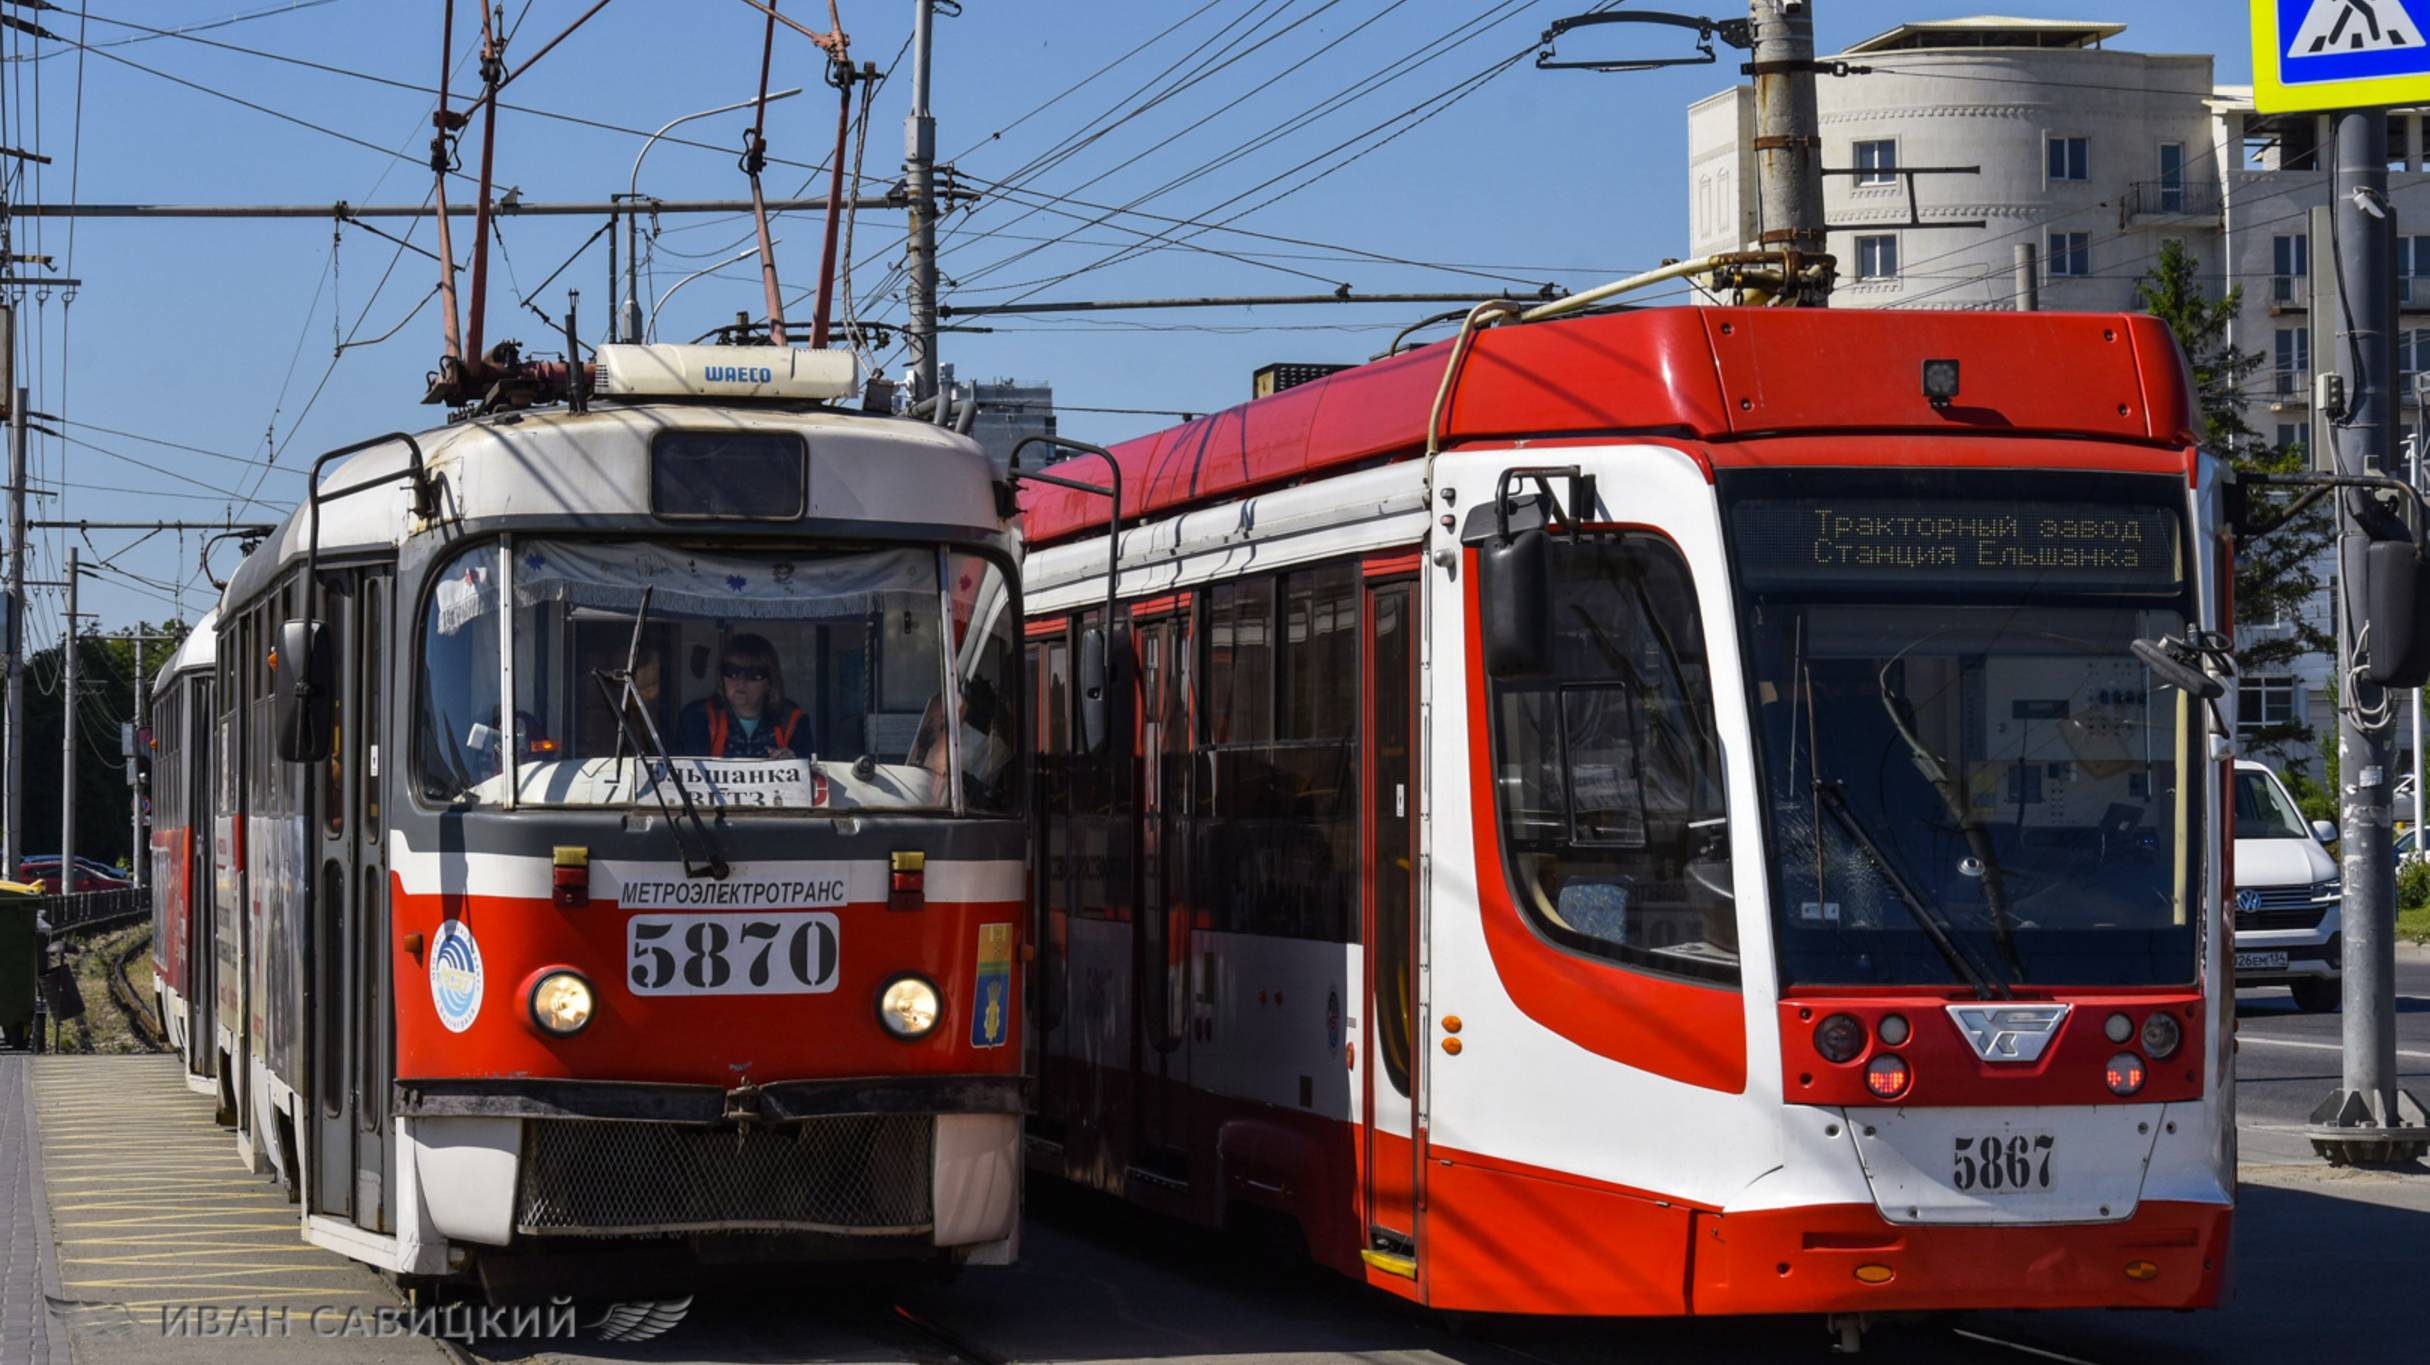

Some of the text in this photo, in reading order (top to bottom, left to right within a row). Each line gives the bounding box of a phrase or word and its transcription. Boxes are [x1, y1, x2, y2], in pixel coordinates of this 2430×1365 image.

[705, 366, 772, 383] WAECO
[1814, 509, 2142, 542] Тракторный завод
[1814, 538, 2139, 567] Станция Ельшанка
[621, 880, 844, 904] МЕТРОЭЛЕКТРОТРАНС
[631, 920, 837, 989] 5870
[1953, 1134, 2055, 1190] 5867
